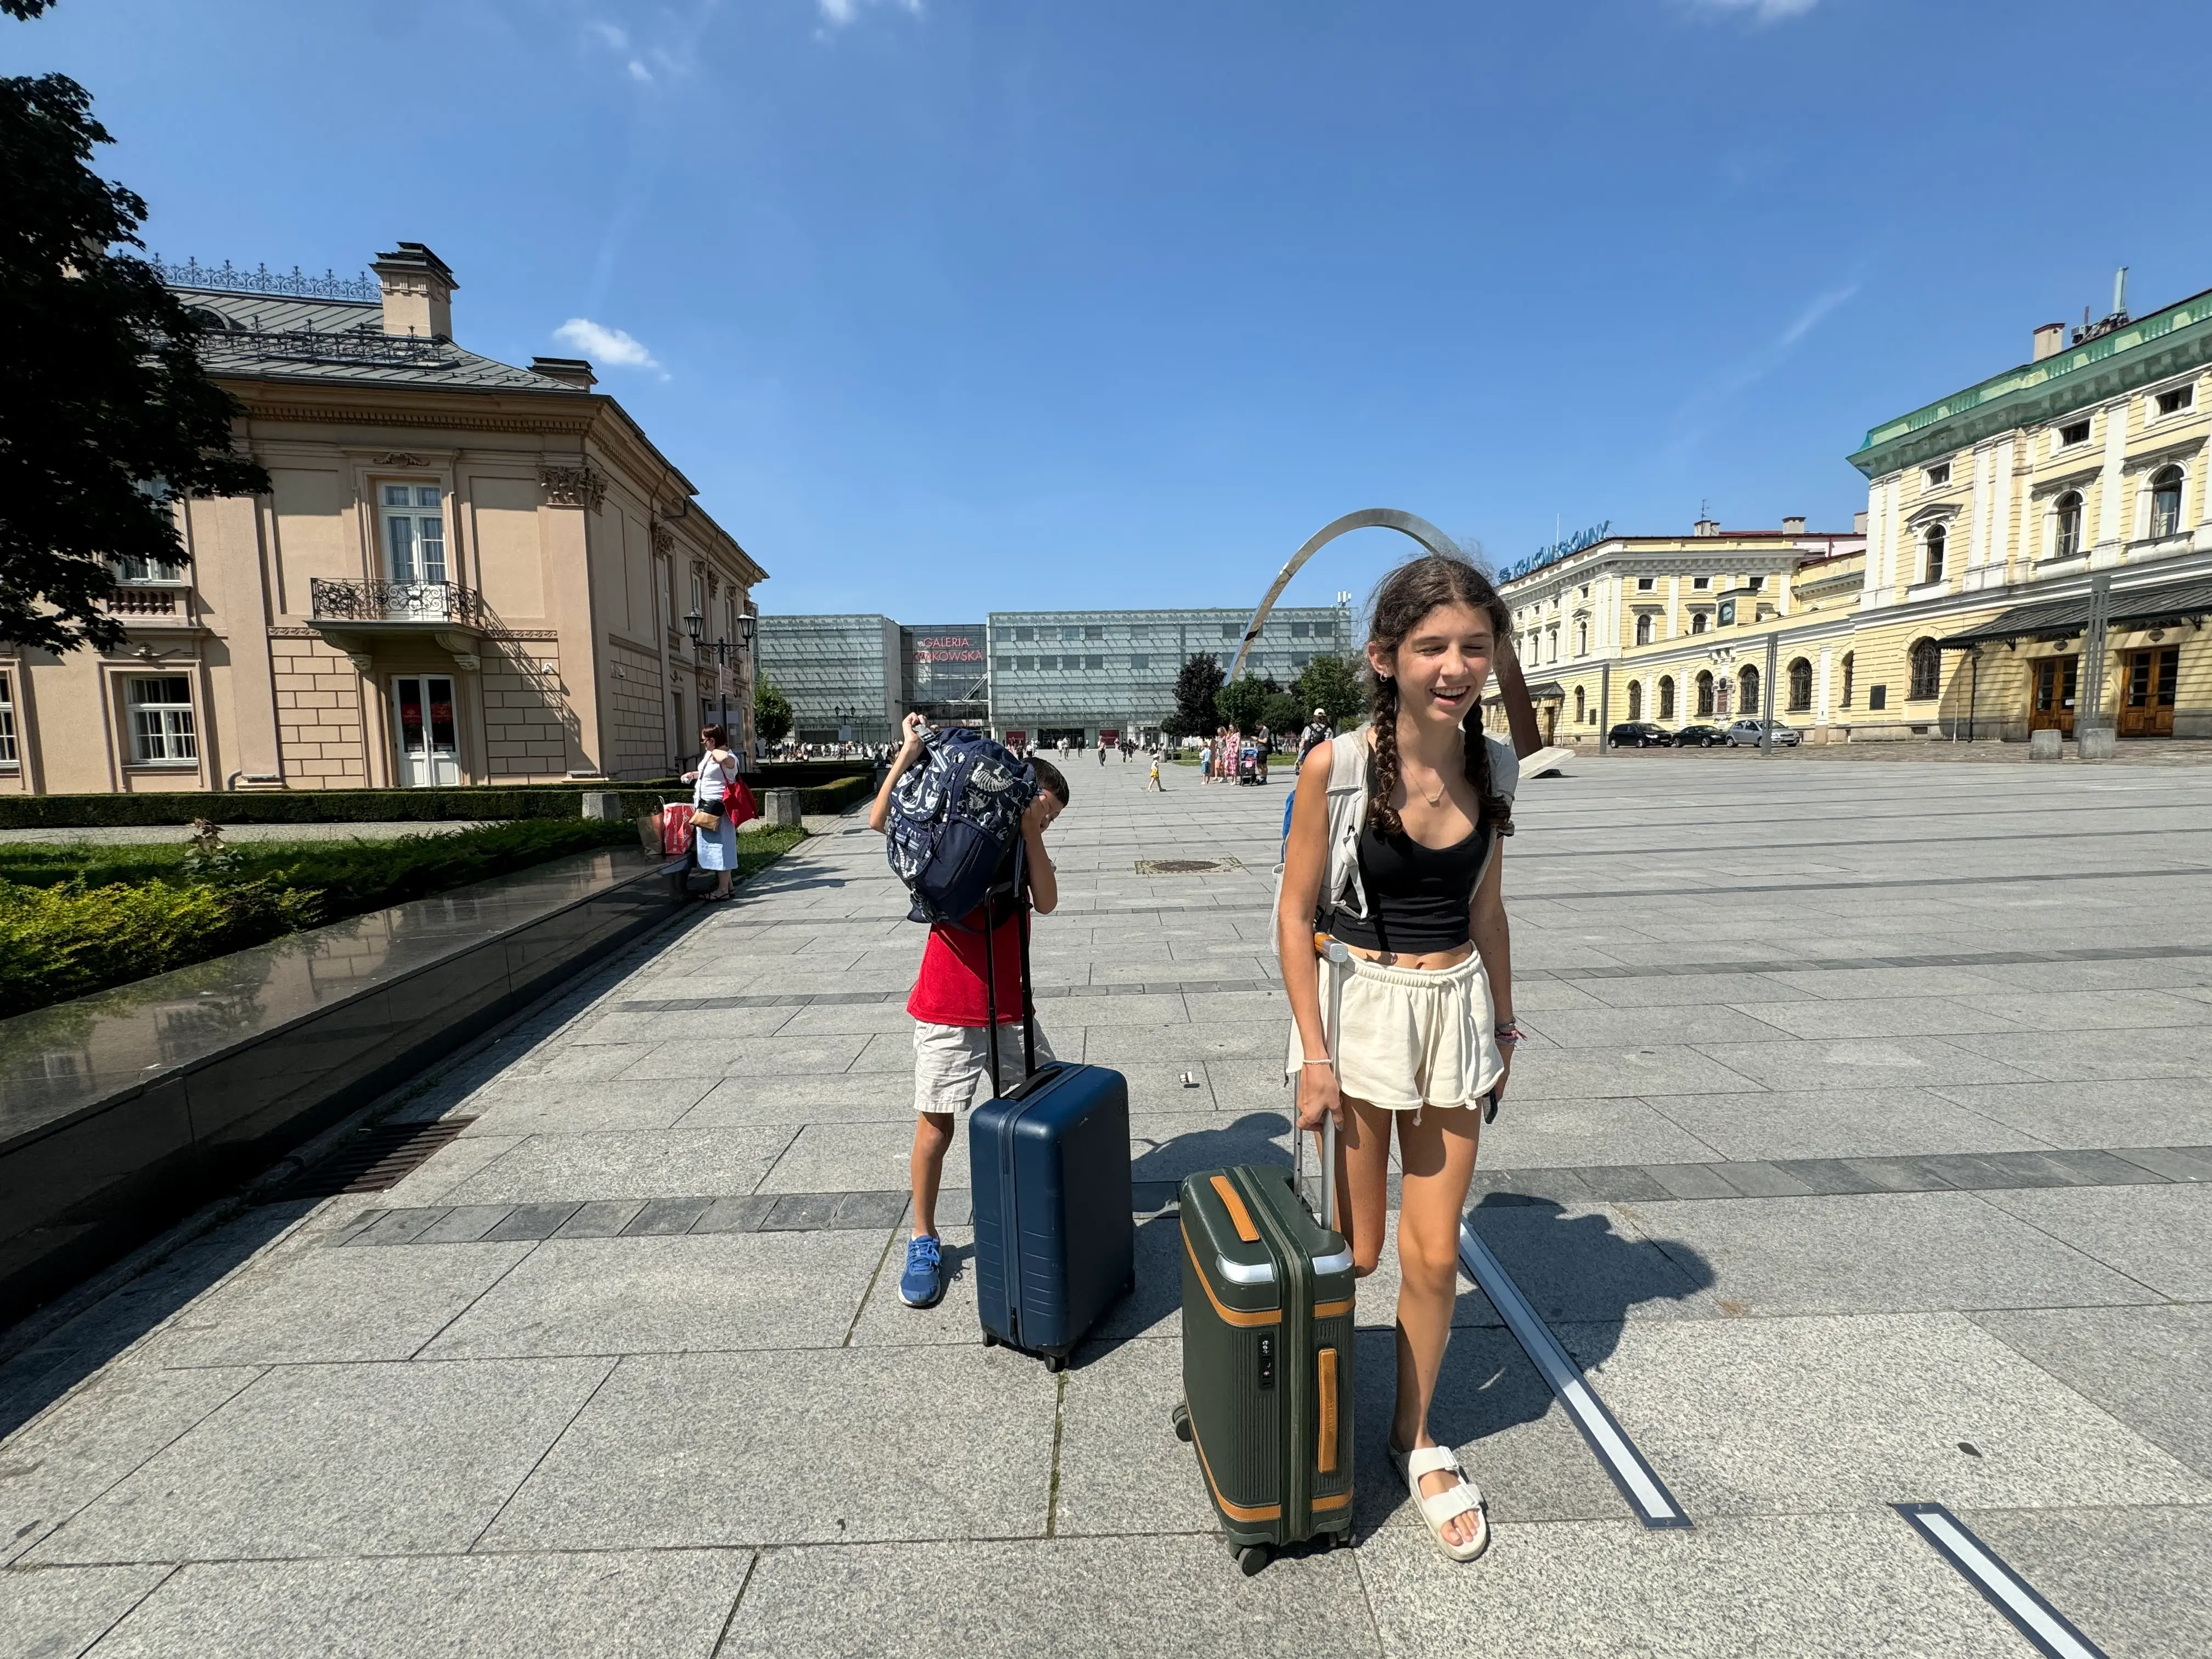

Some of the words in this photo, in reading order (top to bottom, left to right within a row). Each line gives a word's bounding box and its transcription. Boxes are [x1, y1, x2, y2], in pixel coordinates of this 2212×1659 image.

[1514, 544, 1556, 578] KRAKÓW
[1558, 520, 1610, 558] GŁÓWNY
[923, 637, 969, 648] GALERIA
